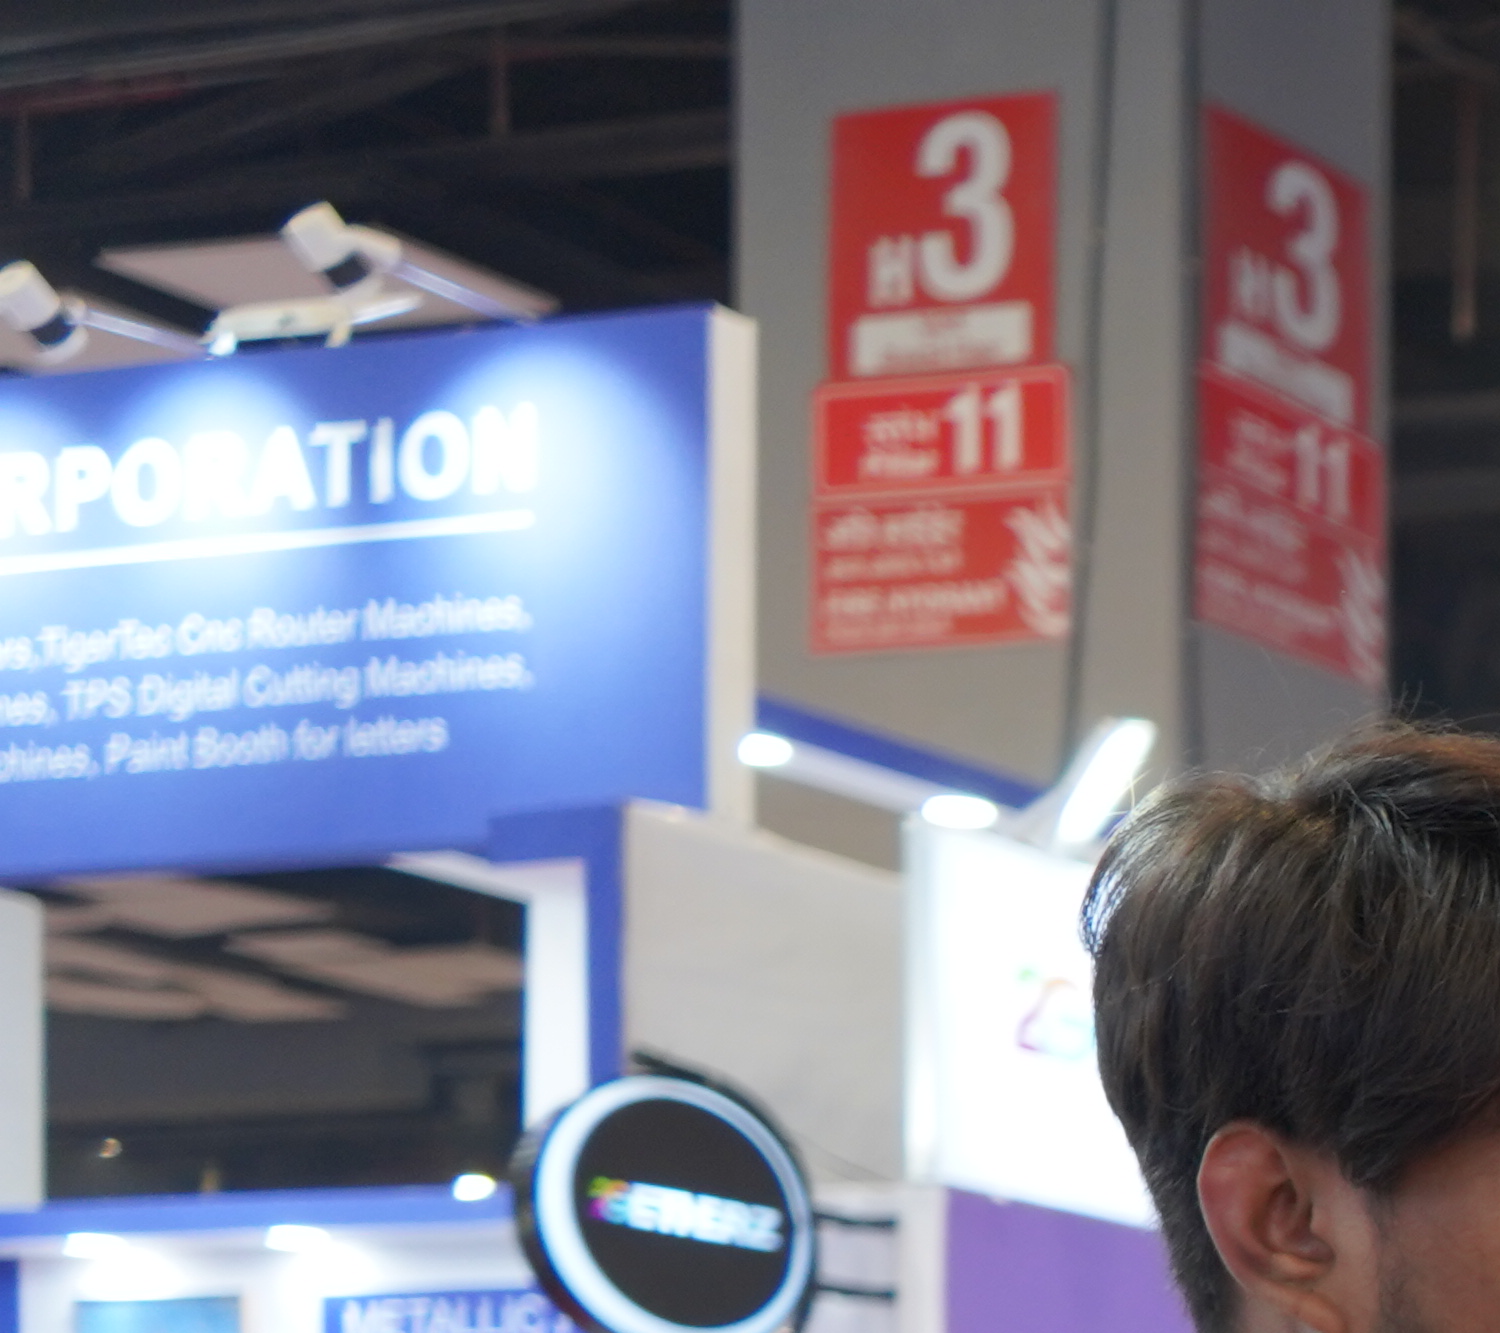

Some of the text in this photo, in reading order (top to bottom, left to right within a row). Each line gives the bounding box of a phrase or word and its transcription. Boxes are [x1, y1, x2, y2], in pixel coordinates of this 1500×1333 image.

[942, 378, 1022, 476] 11
[246, 605, 359, 650] Router
[65, 675, 131, 720] TPS
[137, 669, 239, 724] Digital
[243, 659, 361, 711] Cutting
[105, 730, 189, 774] Paint
[193, 722, 289, 770] Booth
[293, 718, 339, 762] for
[344, 716, 450, 758] letters
